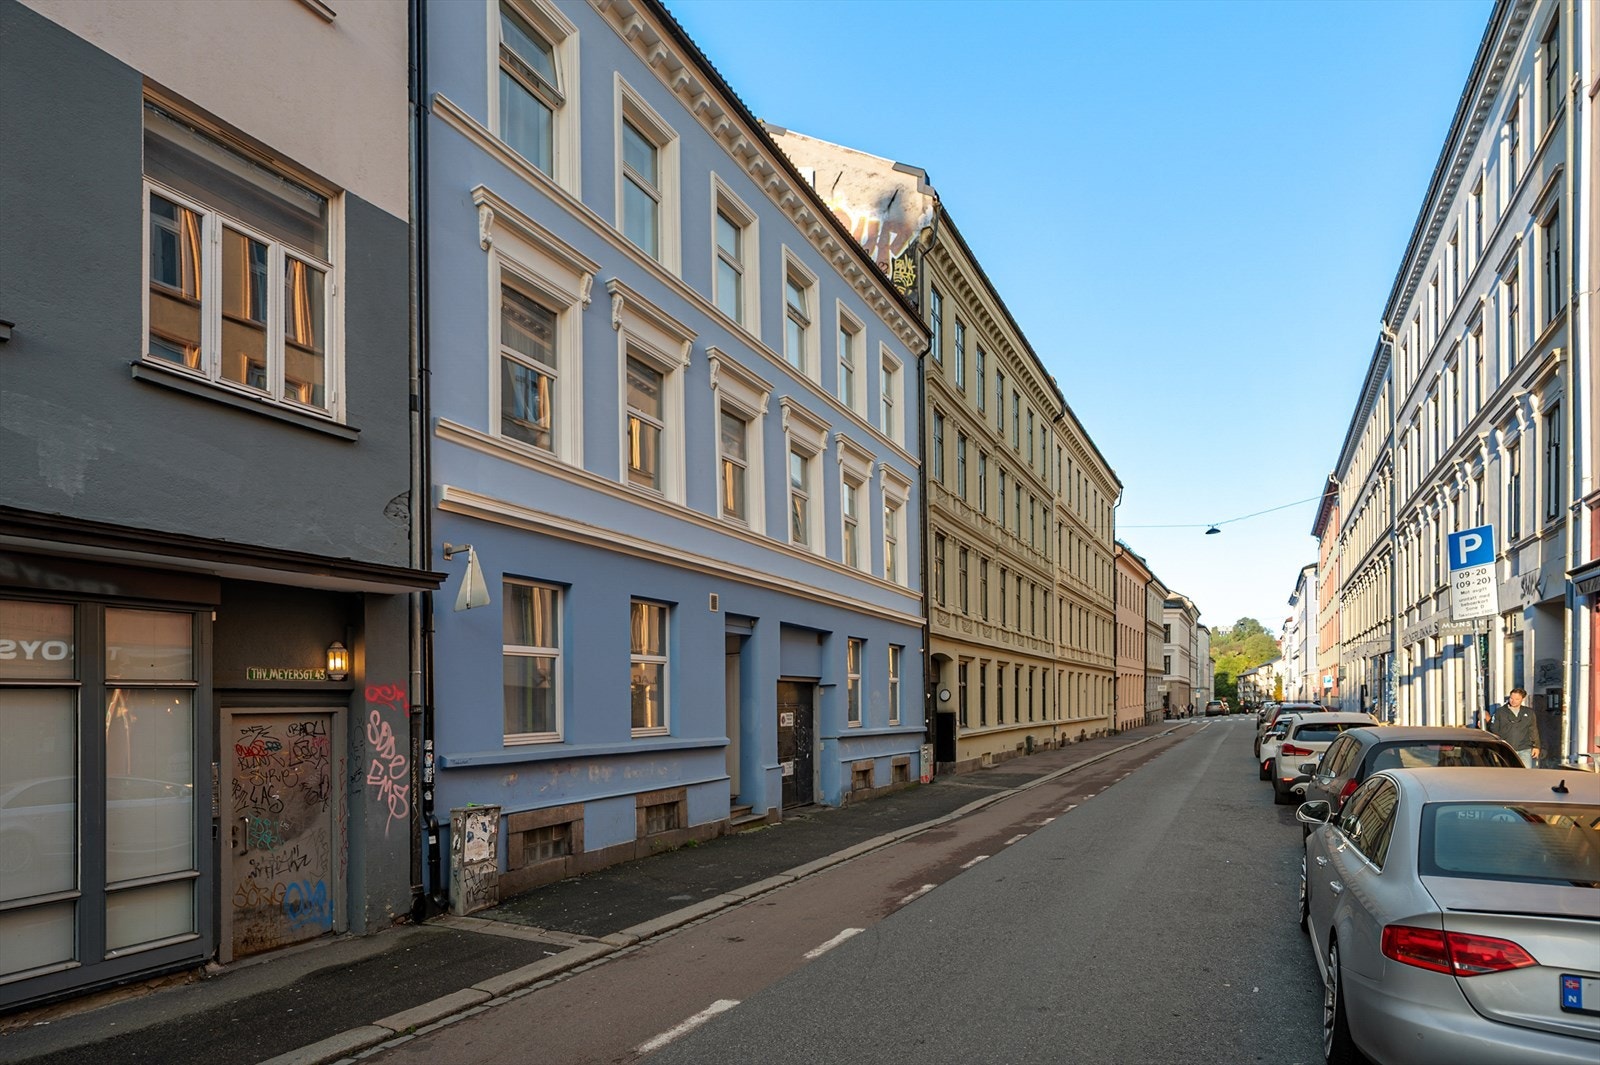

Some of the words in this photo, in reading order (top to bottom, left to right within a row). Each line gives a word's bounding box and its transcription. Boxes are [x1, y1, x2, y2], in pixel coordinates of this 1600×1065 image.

[1459, 534, 1483, 565] P
[1441, 620, 1485, 629] MONSN
[314, 668, 326, 680] 43
